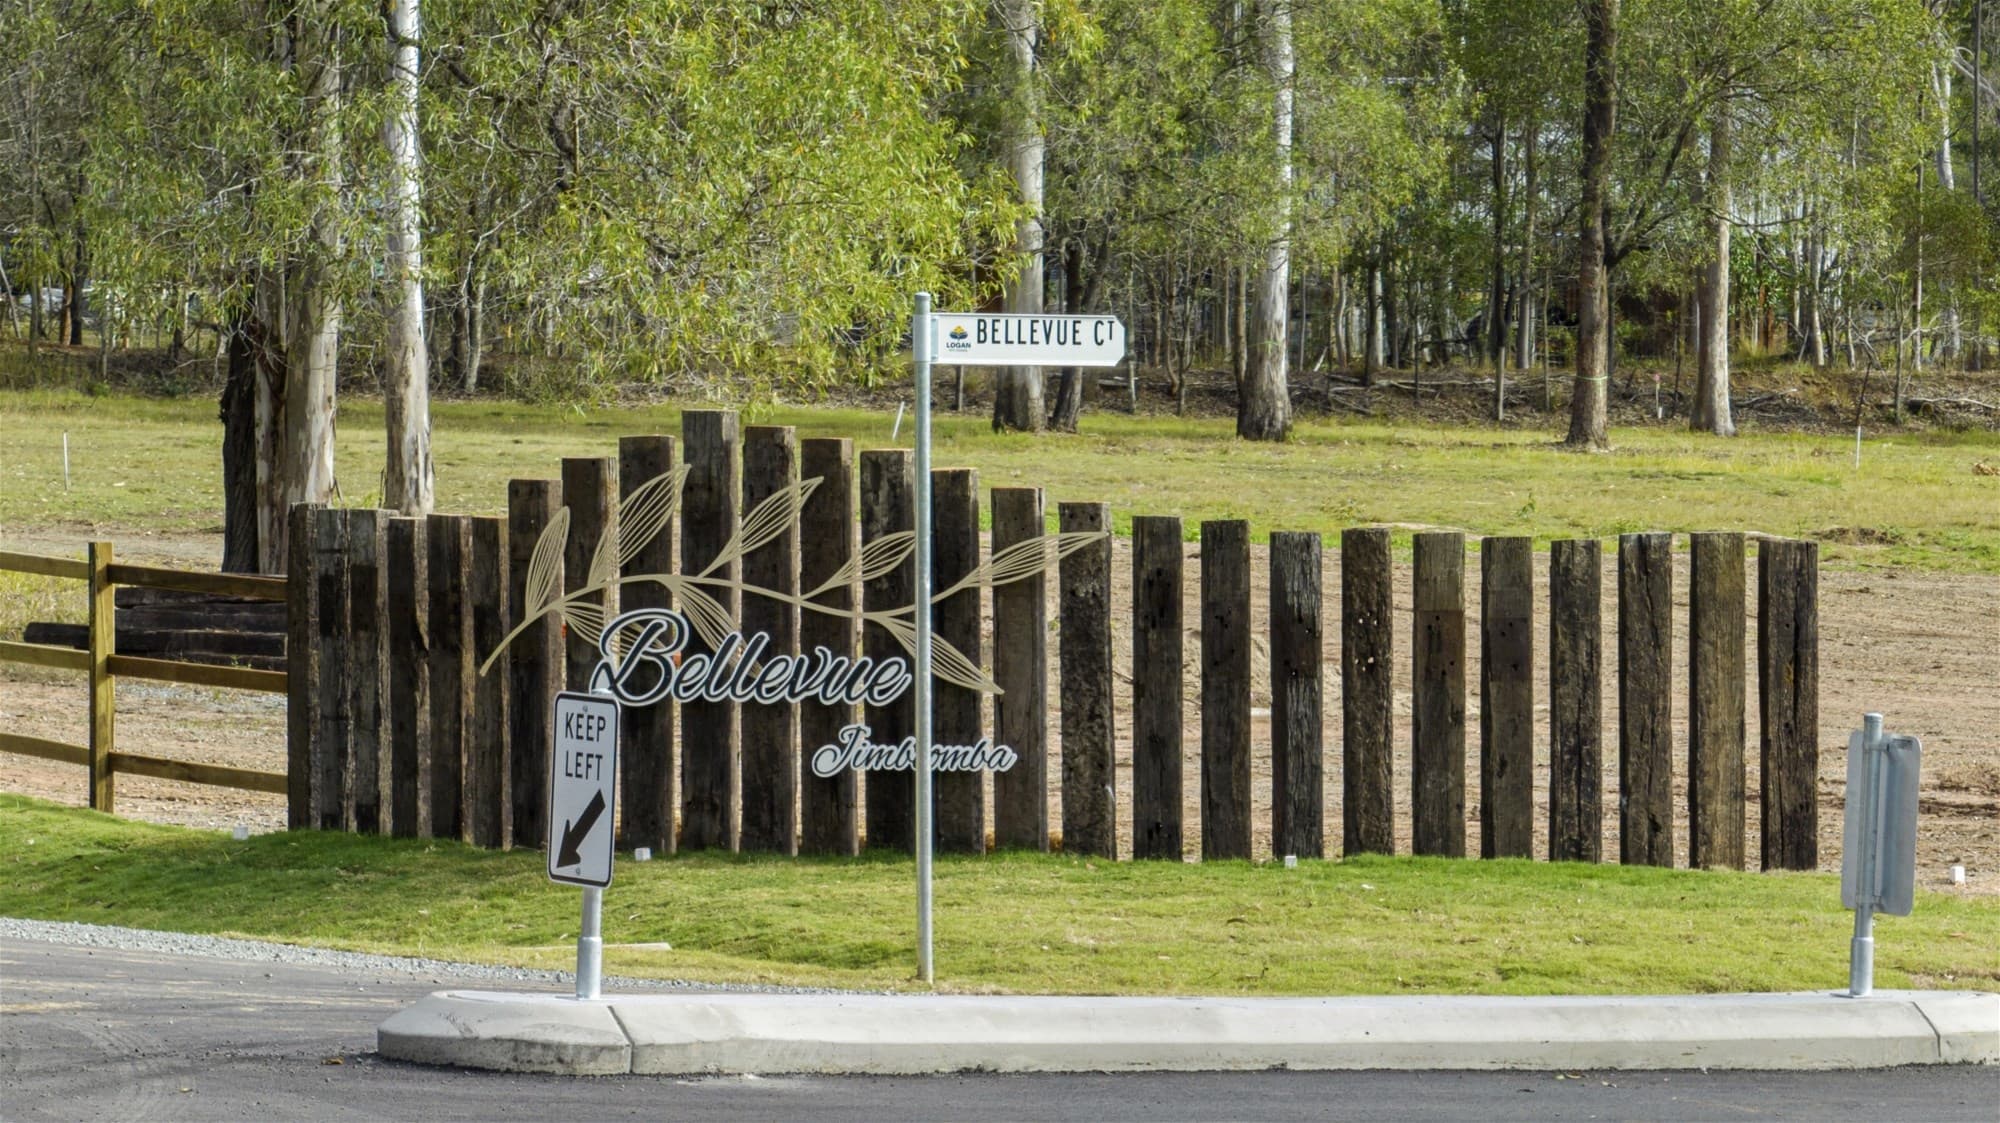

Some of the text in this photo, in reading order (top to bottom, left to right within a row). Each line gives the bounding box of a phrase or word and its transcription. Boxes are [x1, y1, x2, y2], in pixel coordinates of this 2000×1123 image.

[977, 318, 1115, 346] BELLEVUE CT
[590, 608, 912, 707] Bellevue
[565, 711, 606, 742] KEEP
[565, 749, 603, 781] LEFT
[812, 723, 1018, 778] Jimbomba
